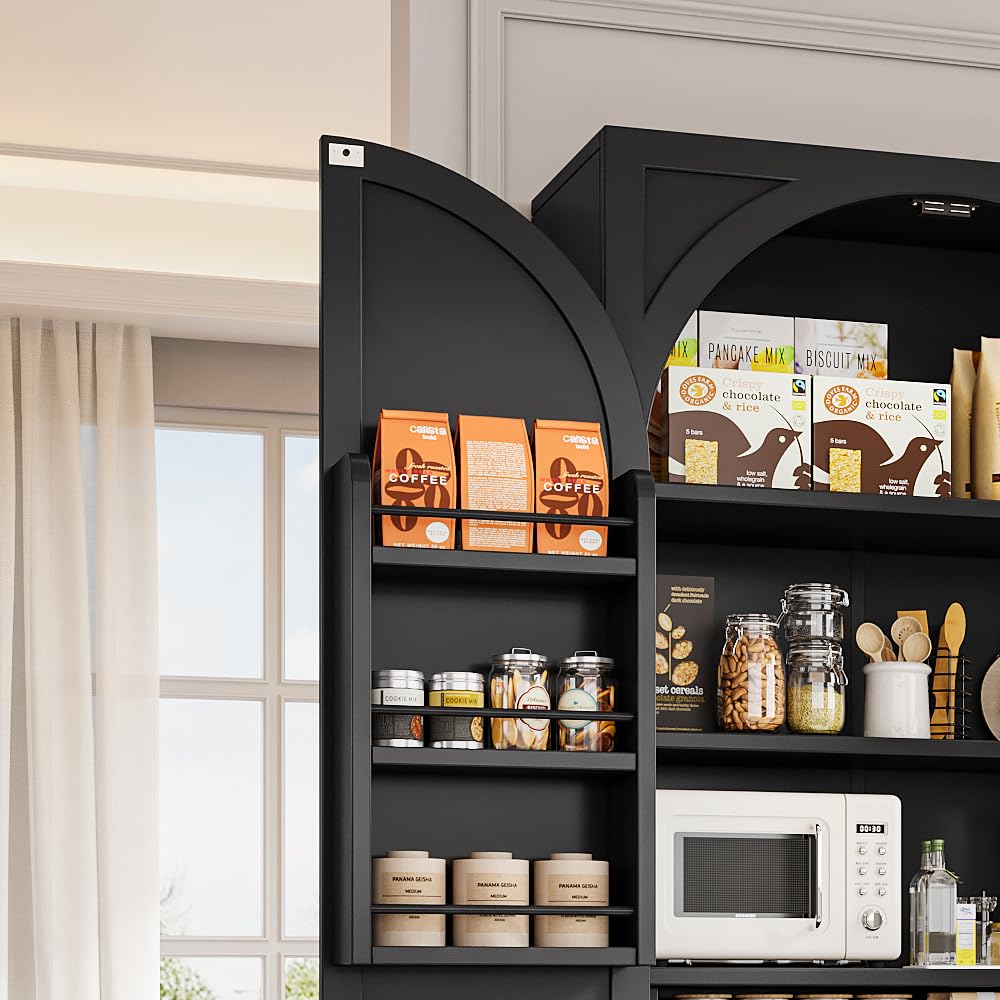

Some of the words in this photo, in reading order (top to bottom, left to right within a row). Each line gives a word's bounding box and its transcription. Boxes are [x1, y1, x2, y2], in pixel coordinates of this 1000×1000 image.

[708, 342, 760, 364] PANCAKE
[765, 346, 785, 365] MIX
[806, 349, 851, 369] BISCUIT
[857, 353, 877, 371] MIX
[681, 377, 697, 395] DOVES
[722, 377, 763, 391] Crispy
[685, 392, 715, 406] ORGANIC
[722, 389, 781, 402] chocolate
[865, 387, 905, 400] Crispy
[722, 401, 732, 411] &
[736, 402, 760, 412] rice
[829, 401, 858, 415] ORGANIC
[865, 399, 922, 411] chocolate
[865, 411, 875, 420] &
[879, 411, 902, 421] rice
[691, 428, 703, 436] bars
[388, 473, 448, 485] COFFEE
[543, 482, 601, 494] COFFEE
[670, 685, 704, 695] cereals
[859, 825, 882, 833] 00:30
